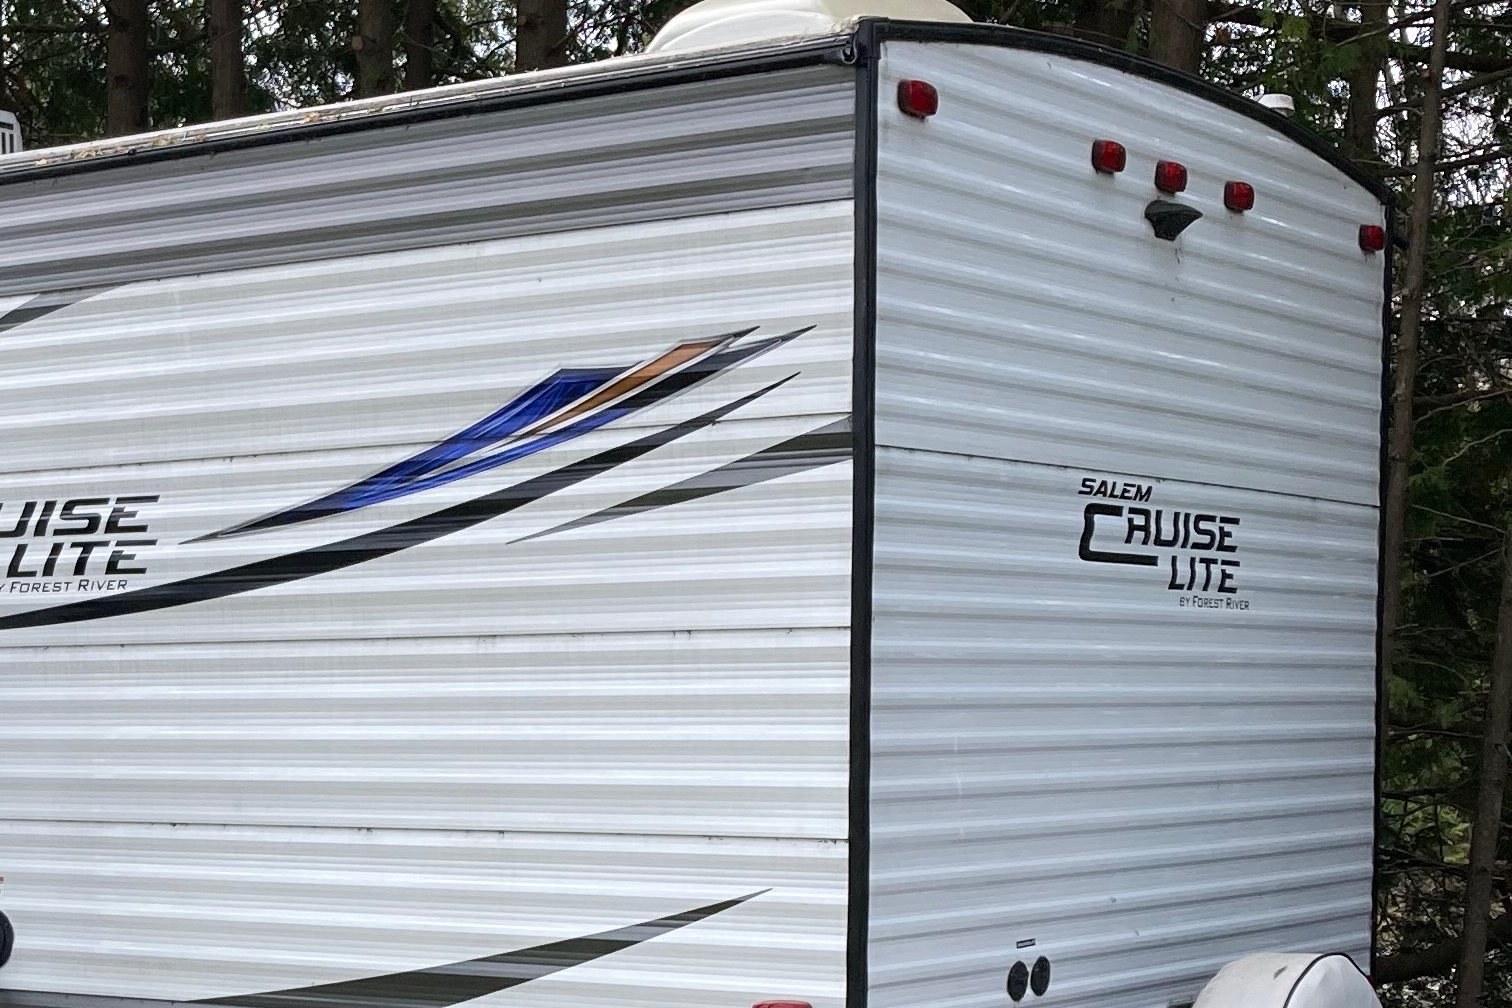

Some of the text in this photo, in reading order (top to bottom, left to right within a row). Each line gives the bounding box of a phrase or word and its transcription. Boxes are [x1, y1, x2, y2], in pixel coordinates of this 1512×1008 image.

[1078, 477, 1153, 502] SALEM
[1078, 503, 1240, 566] CRUISE
[6, 539, 158, 578] LITE
[1168, 555, 1240, 594] LITE
[9, 580, 72, 594] FOREST
[77, 578, 128, 592] RIVER
[1179, 595, 1250, 611] BY FOREST RIVER
